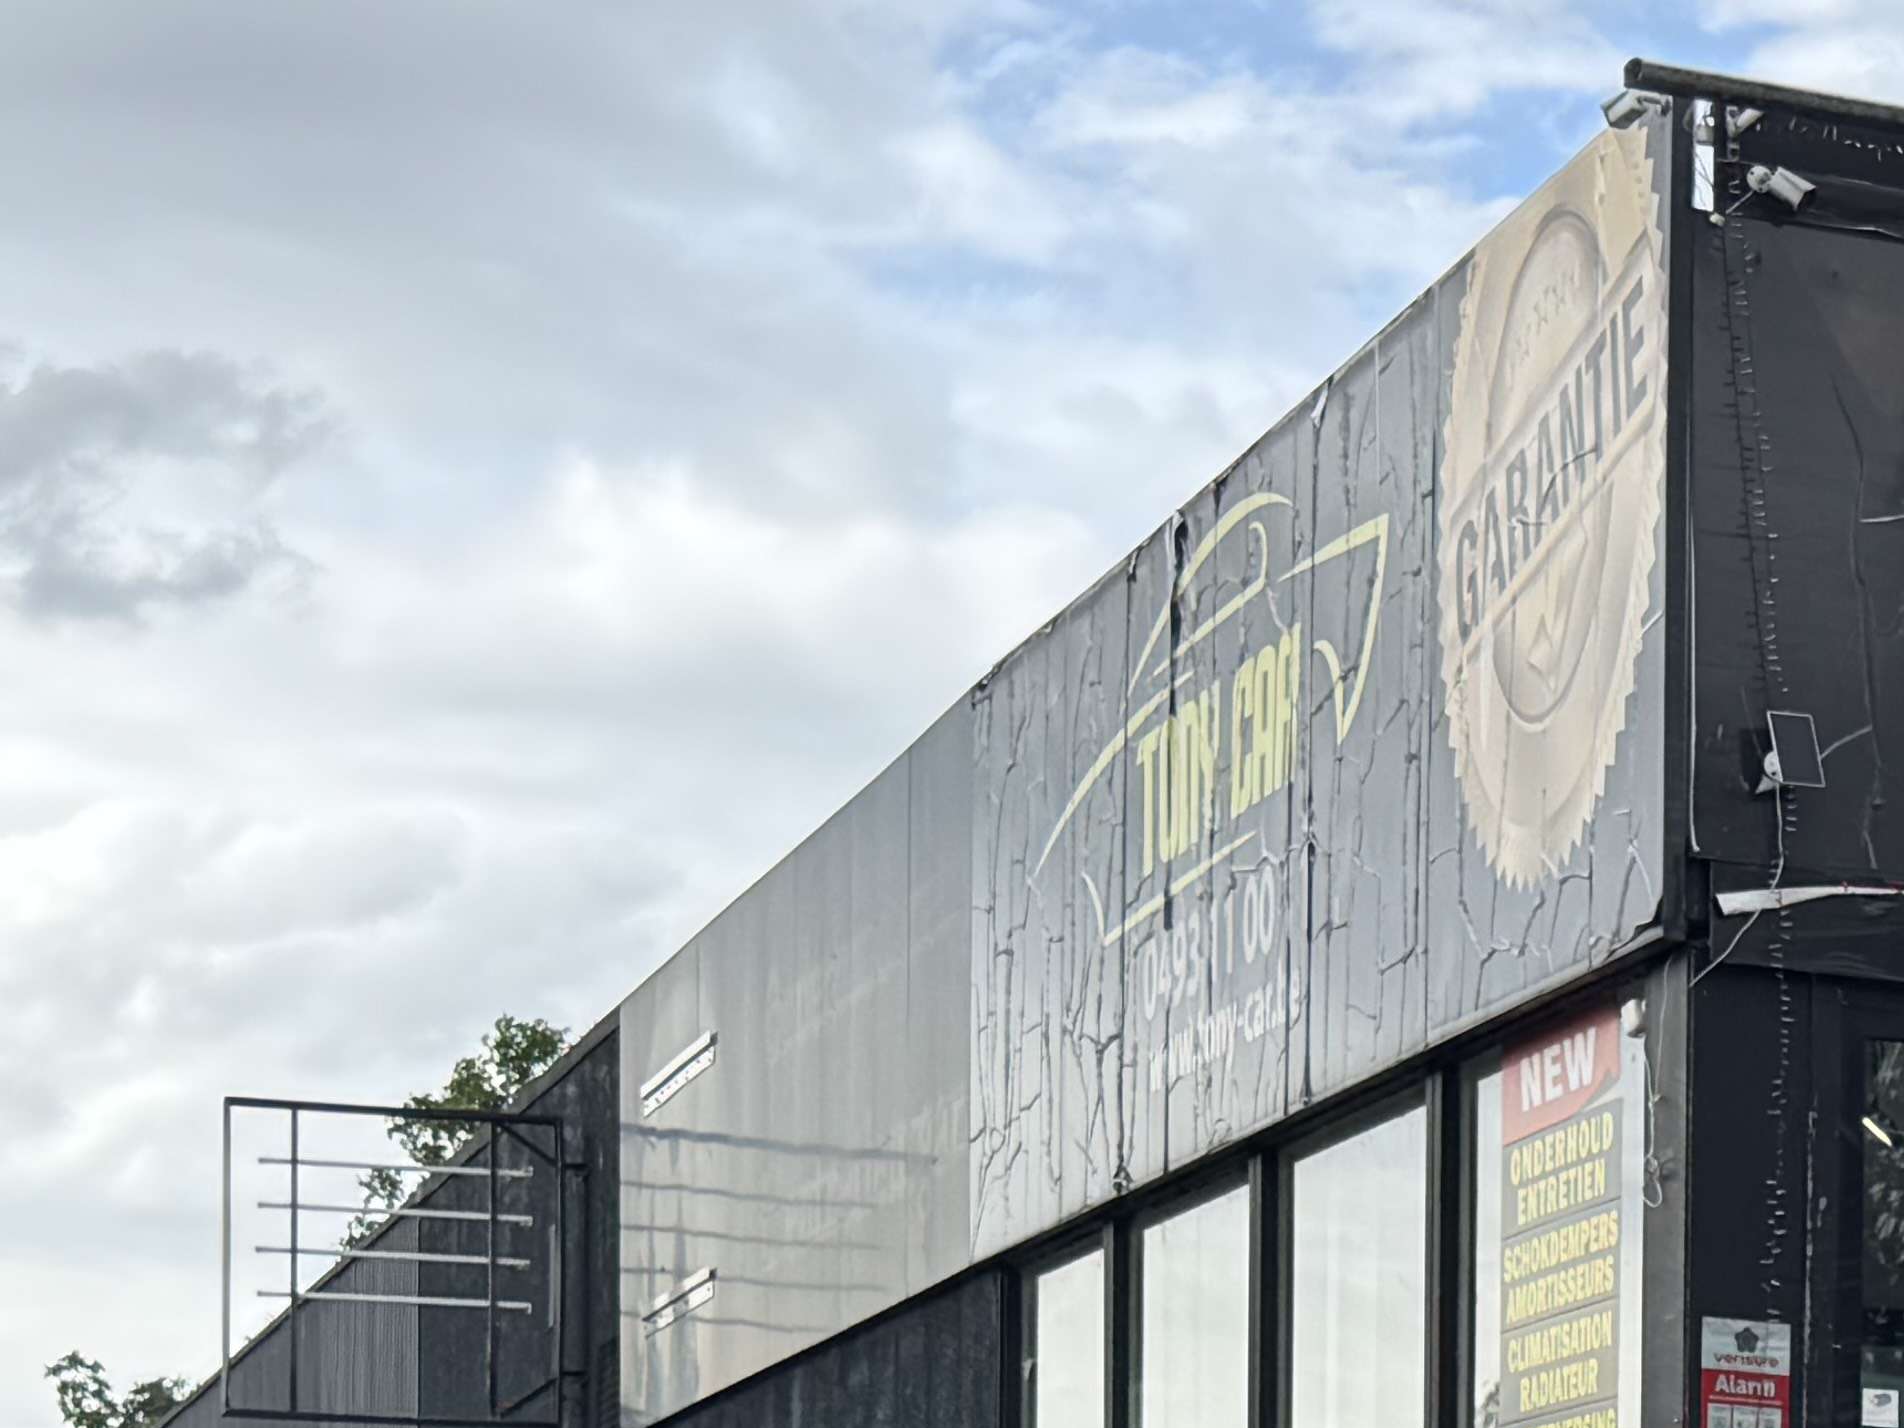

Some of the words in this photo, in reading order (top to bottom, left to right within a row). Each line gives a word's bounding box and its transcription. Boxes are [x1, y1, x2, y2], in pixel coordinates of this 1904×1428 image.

[1455, 274, 1649, 648] GARANTIE
[1135, 679, 1221, 877] TONY
[1242, 863, 1276, 964] 00
[1519, 1026, 1597, 1113] NEW
[1509, 1111, 1614, 1186] ONDERHOUD
[1517, 1158, 1606, 1226] ENTRETIEN
[1503, 1209, 1619, 1284] SCHOKDEMPERS
[1507, 1255, 1614, 1326] AMORTISSEURS
[1507, 1310, 1613, 1374] CLIMATISATION
[1519, 1357, 1599, 1414] RADIATEUR
